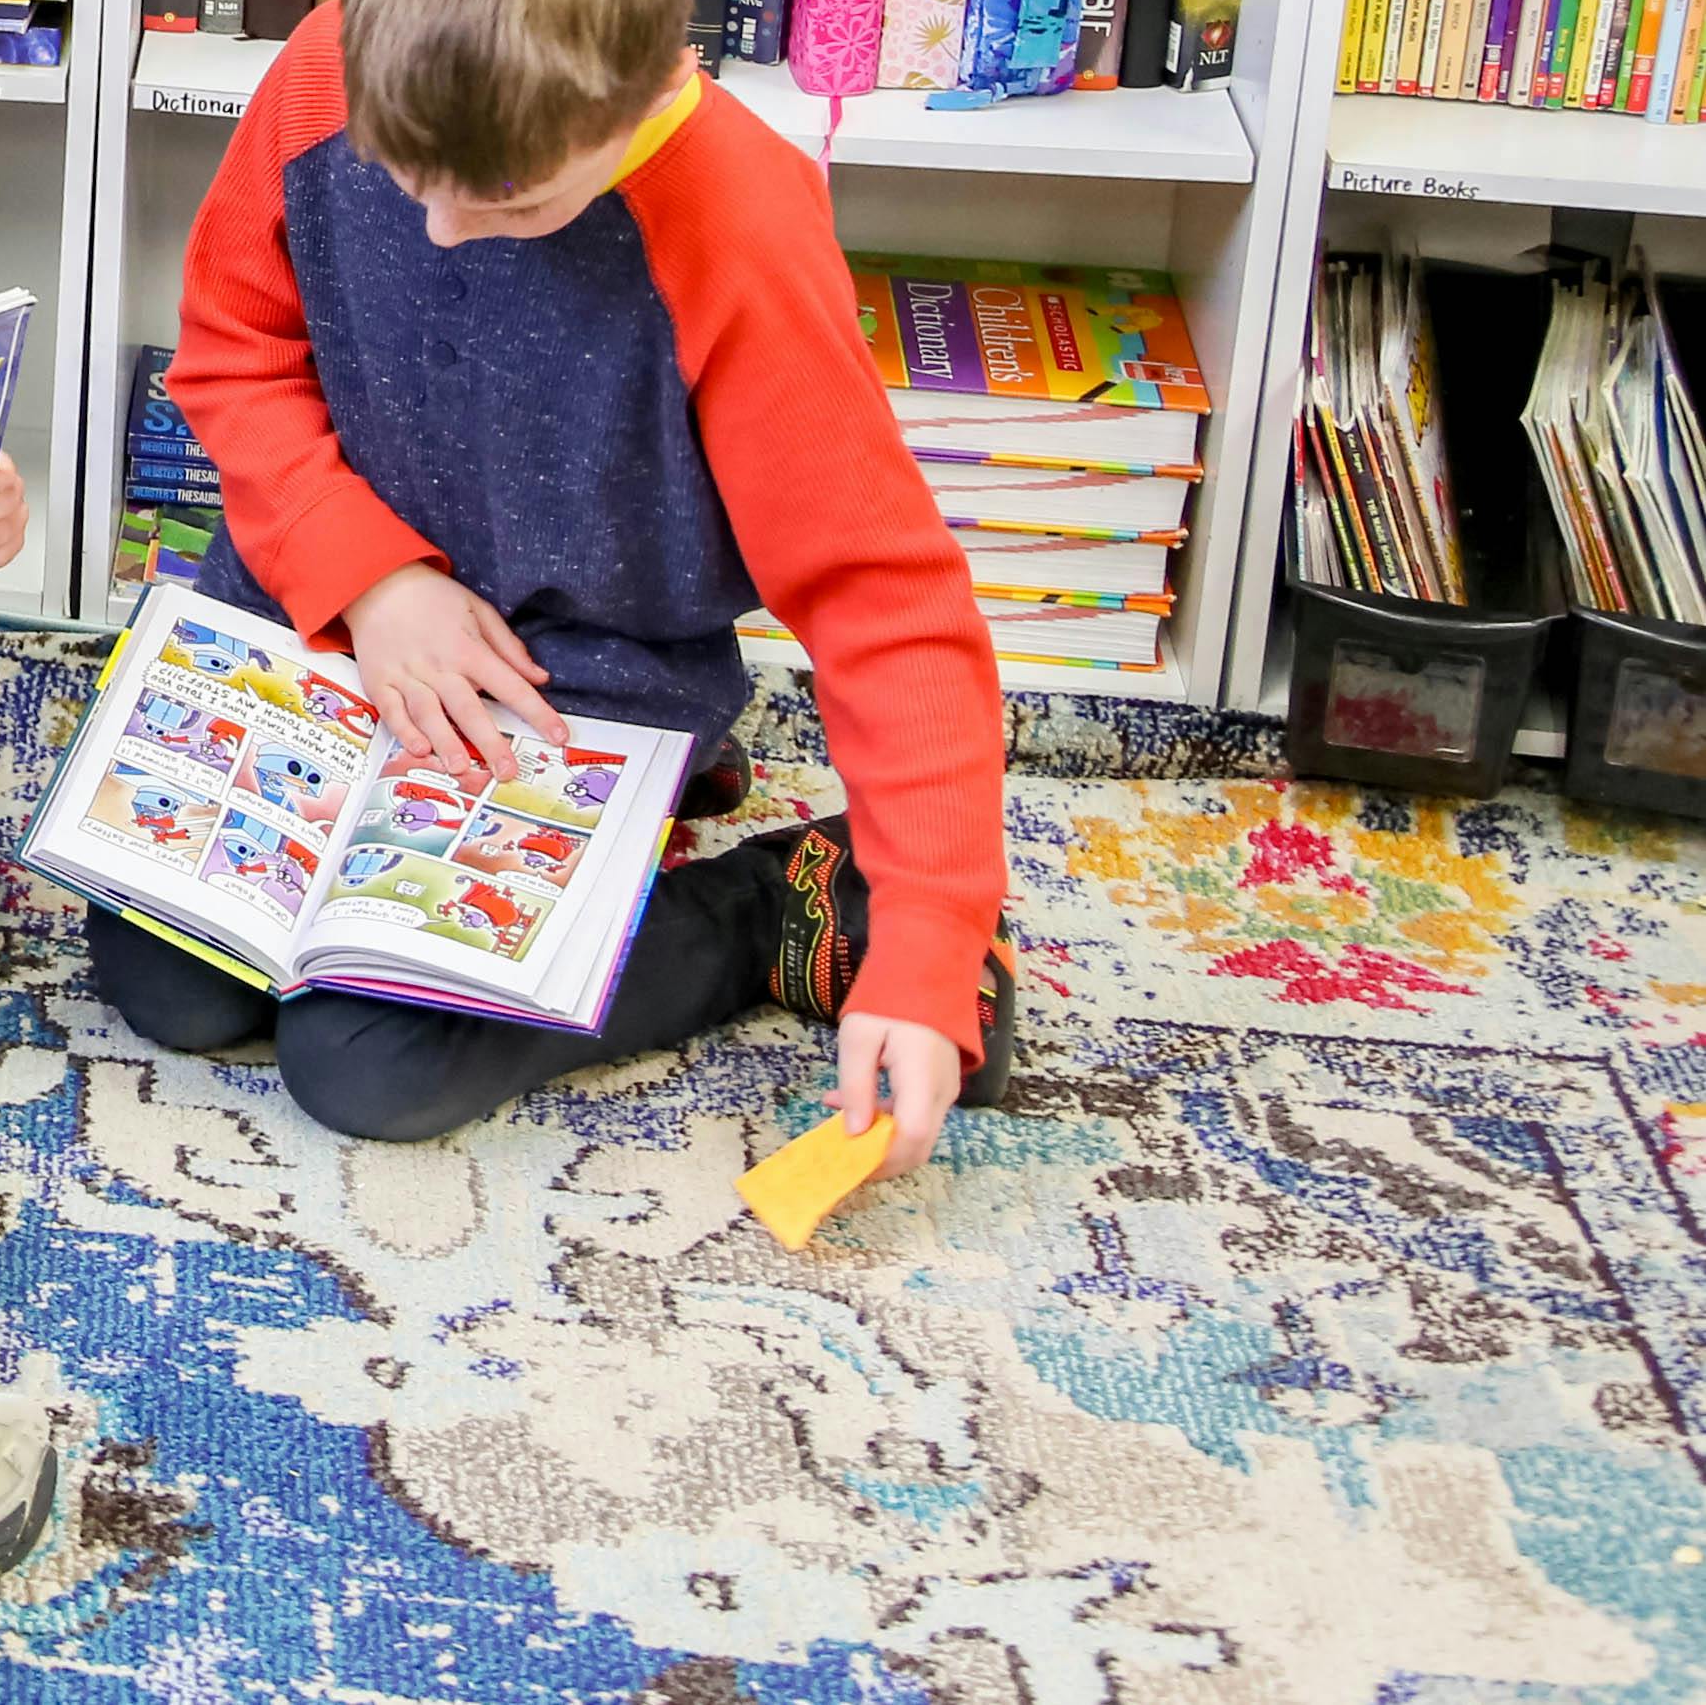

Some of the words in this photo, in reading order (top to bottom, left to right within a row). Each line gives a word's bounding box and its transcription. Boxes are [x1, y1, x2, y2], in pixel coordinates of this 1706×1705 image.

[1198, 49, 1229, 67] NLT
[1342, 170, 1411, 196] Picture
[1422, 177, 1476, 201] Books
[906, 281, 955, 380] Dictionary
[972, 286, 1035, 384] Children's
[1049, 304, 1080, 372] SCHOLASTIC
